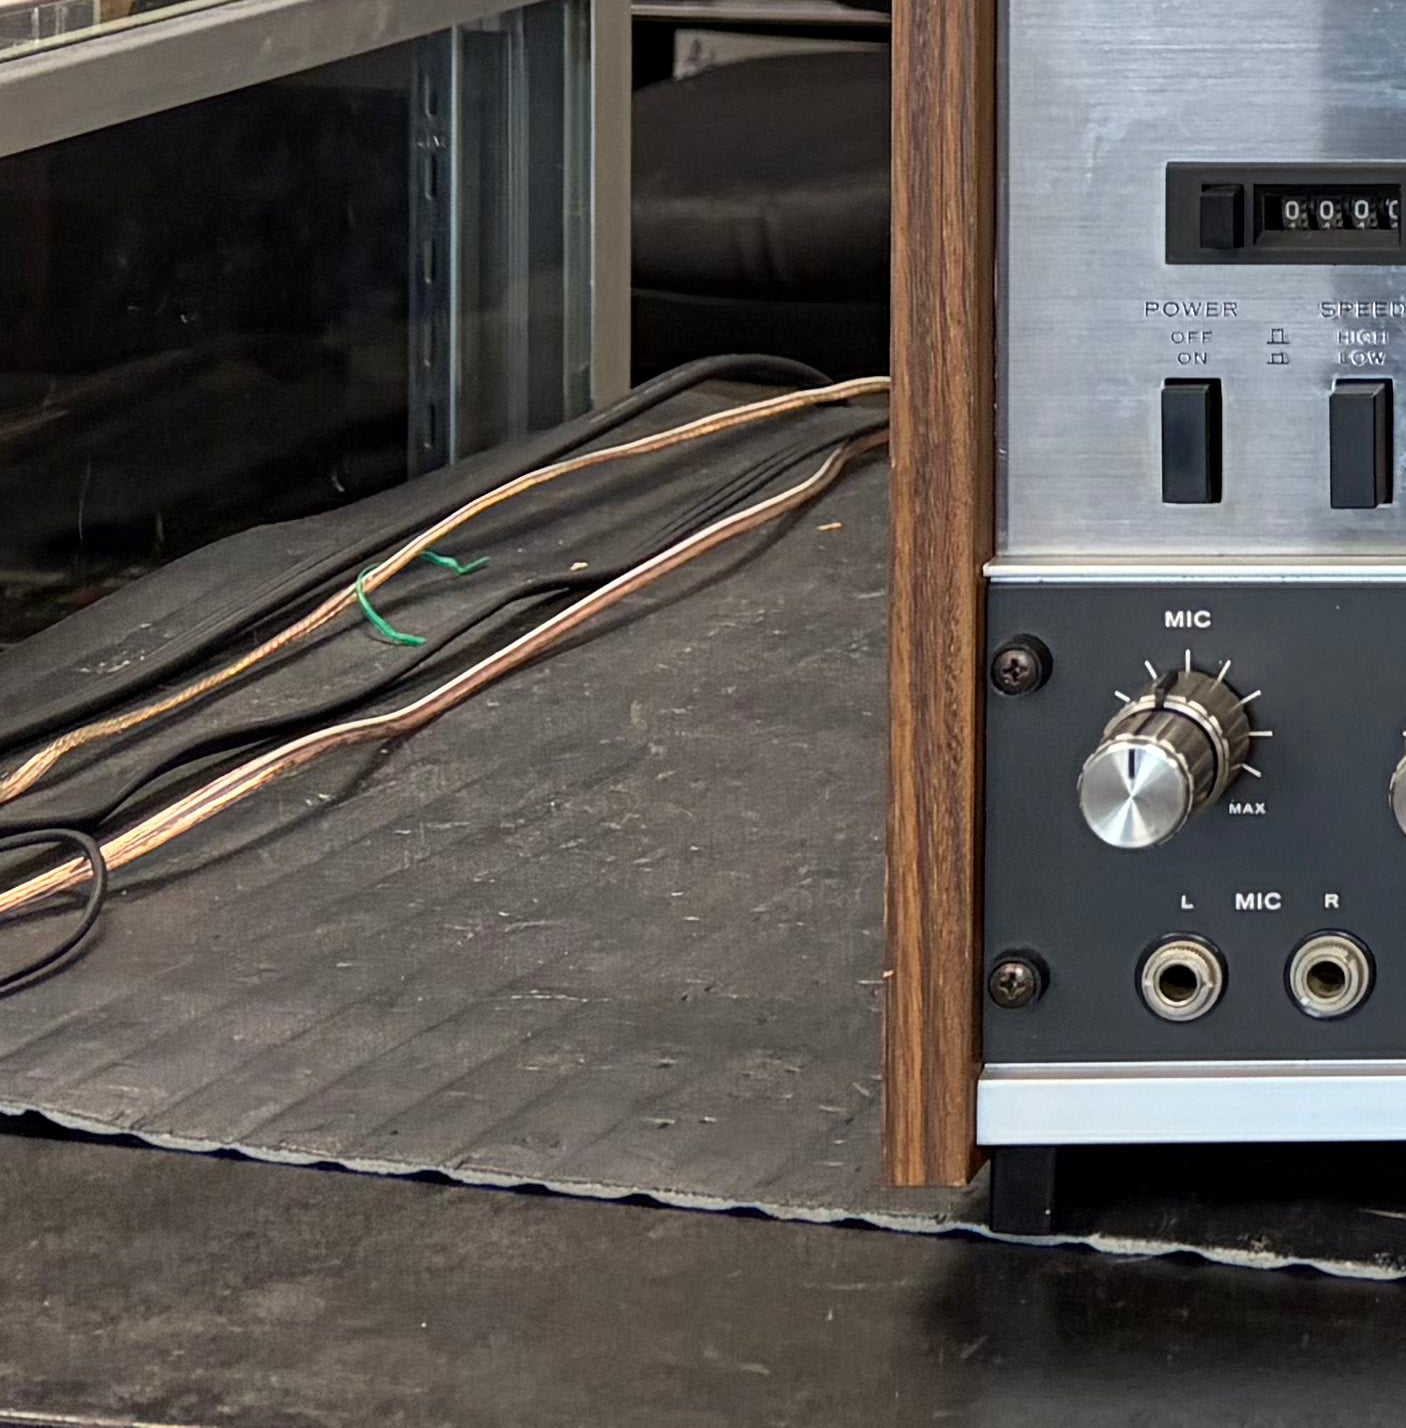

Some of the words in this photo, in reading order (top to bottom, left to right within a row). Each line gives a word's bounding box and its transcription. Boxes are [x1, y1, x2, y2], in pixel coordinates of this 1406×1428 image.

[1144, 301, 1238, 318] POWER
[1170, 331, 1213, 345] OFF
[1337, 330, 1389, 345] HIGH
[1177, 352, 1208, 365] ON
[1338, 351, 1386, 366] LOW
[1164, 610, 1212, 629] MIC
[1229, 802, 1266, 815] MAX
[1181, 895, 1194, 910] L
[1235, 892, 1282, 911] MIC
[1324, 893, 1340, 909] R
